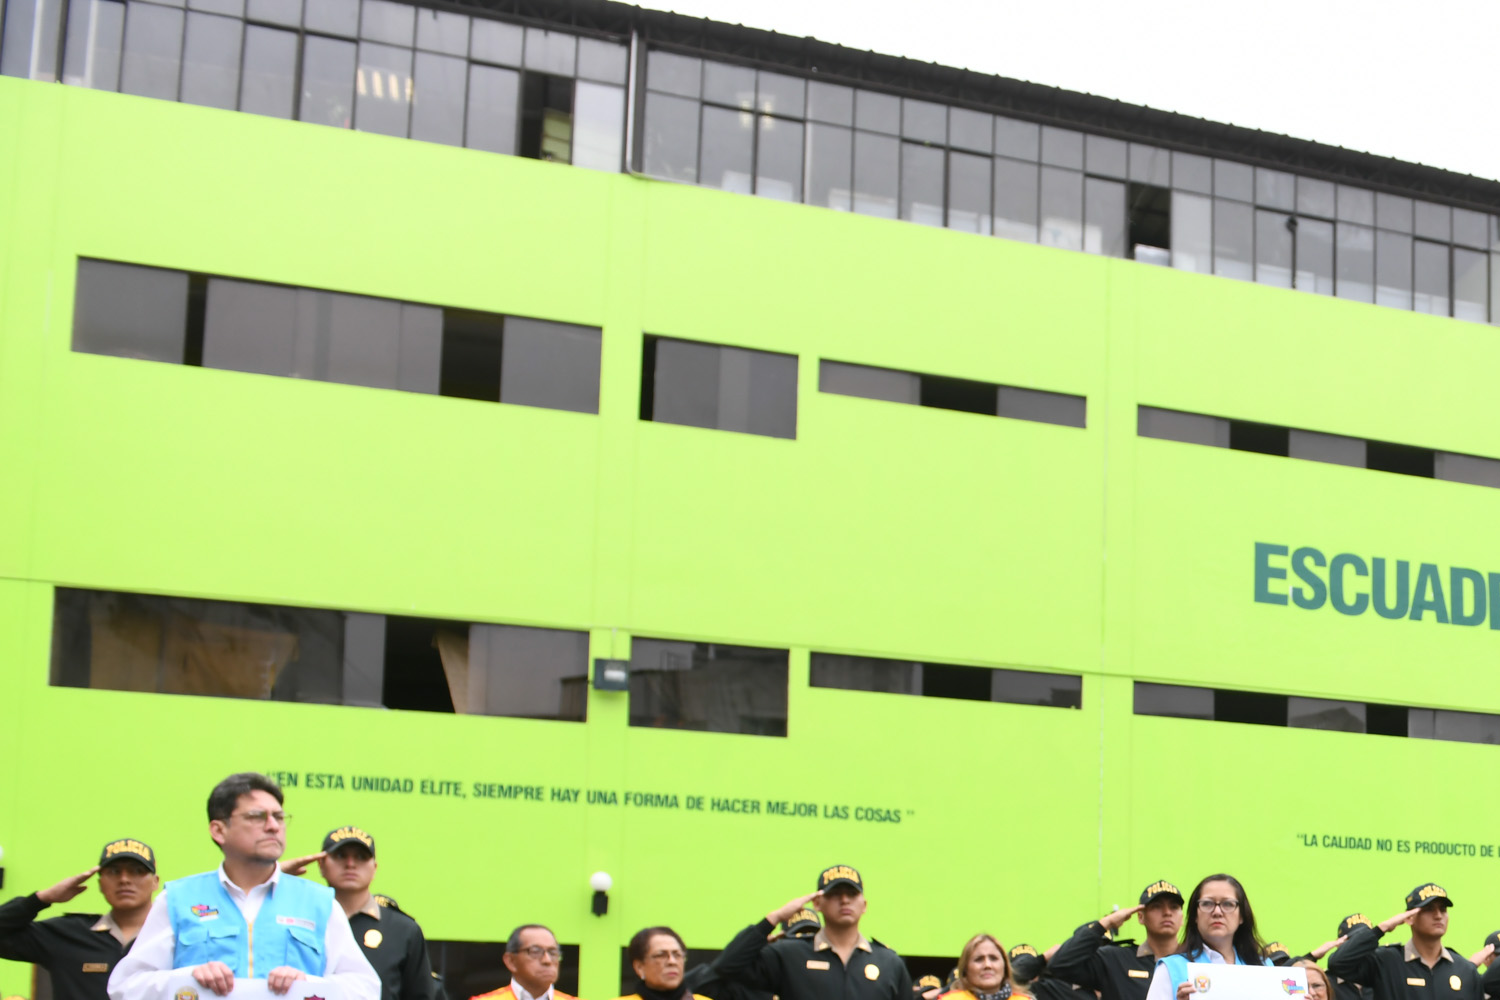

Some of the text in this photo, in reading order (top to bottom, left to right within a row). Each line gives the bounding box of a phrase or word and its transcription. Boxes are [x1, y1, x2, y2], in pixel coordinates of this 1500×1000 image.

[305, 773, 345, 790] ESTA
[352, 776, 414, 794] UNIDAD
[420, 779, 467, 799] ELITE,
[472, 782, 545, 801] SIEMPRE
[550, 787, 581, 803] HAY
[586, 790, 618, 805] UNA
[623, 792, 680, 810] FORMA
[685, 795, 704, 811] DE
[711, 798, 761, 815] HACER
[766, 800, 818, 818] MEJOR
[823, 804, 849, 821] LAS
[1322, 834, 1372, 850] CALIDAD
[1376, 839, 1393, 852] NO
[1397, 840, 1410, 853] ES
[1415, 841, 1476, 857] PRODUCTO
[1480, 844, 1494, 857] DE
